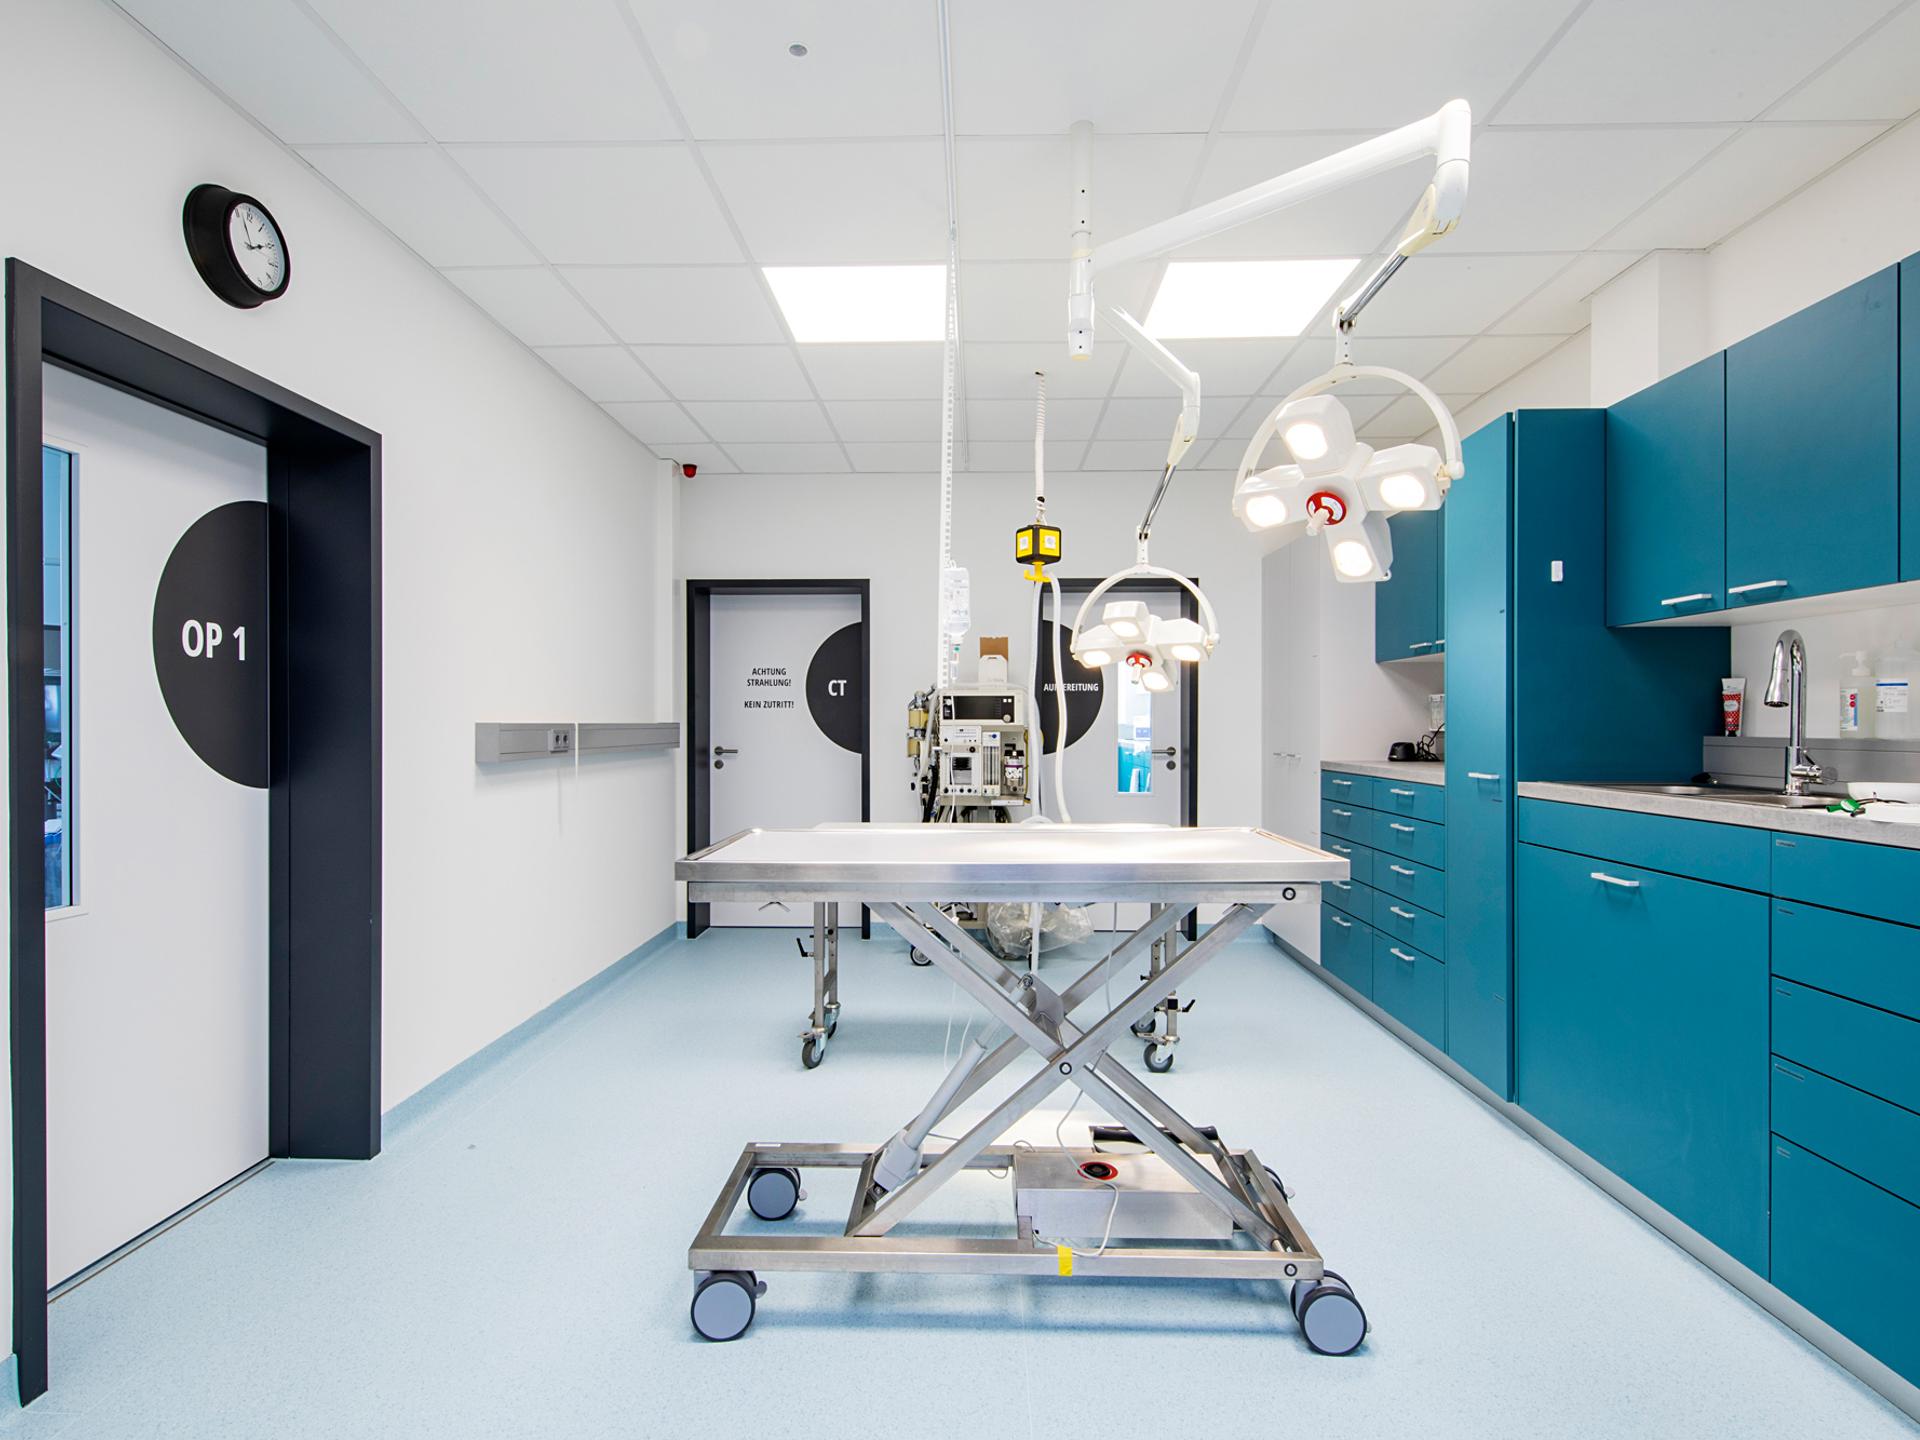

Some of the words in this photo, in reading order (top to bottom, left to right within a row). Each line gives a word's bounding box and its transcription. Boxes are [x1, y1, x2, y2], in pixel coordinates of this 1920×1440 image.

[182, 619, 222, 658] OP
[232, 626, 245, 661] 1
[752, 668, 787, 676] ACHTUNG
[747, 679, 791, 687] STRAHLUNG!
[1043, 683, 1099, 691] AUEREITUNG
[828, 680, 847, 696] CT
[744, 701, 761, 709] KEIN
[763, 701, 794, 709] ZUTRITT!
